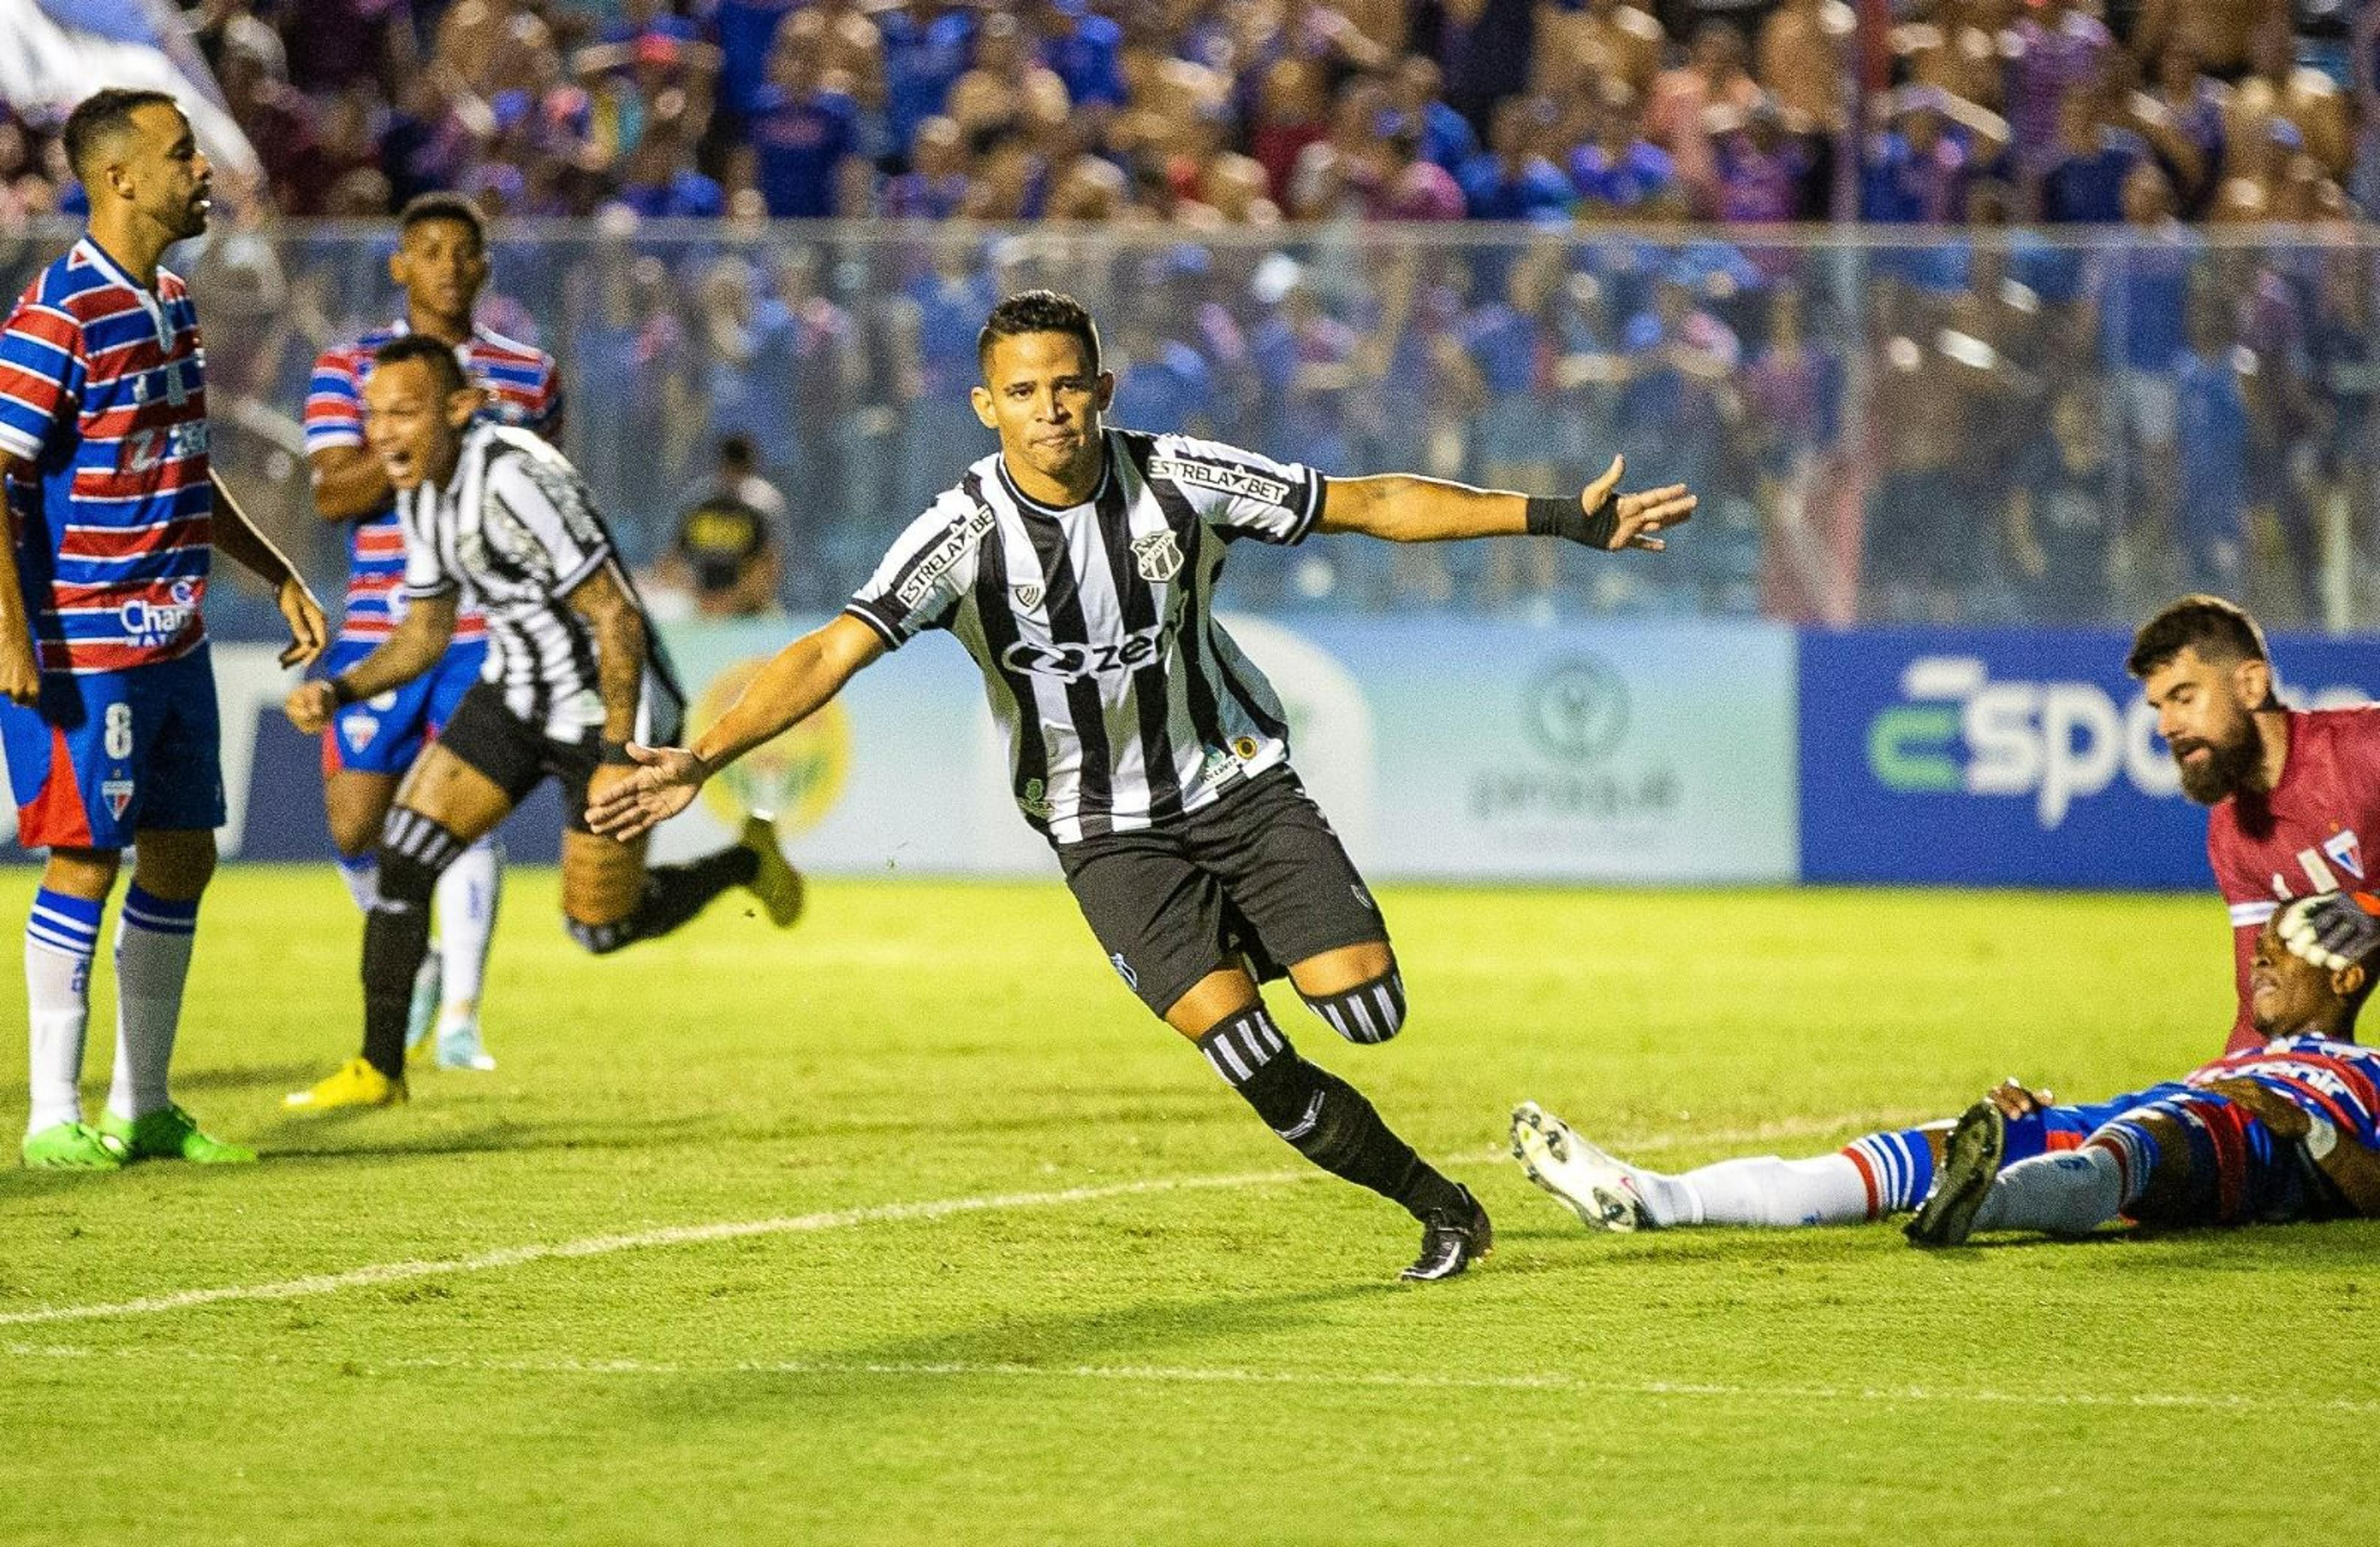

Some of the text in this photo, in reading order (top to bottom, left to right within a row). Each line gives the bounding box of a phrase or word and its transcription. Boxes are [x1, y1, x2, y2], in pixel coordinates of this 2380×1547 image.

[1248, 478, 1284, 501] BET
[899, 508, 995, 604] ESTRELA BE
[105, 702, 133, 760] 8
